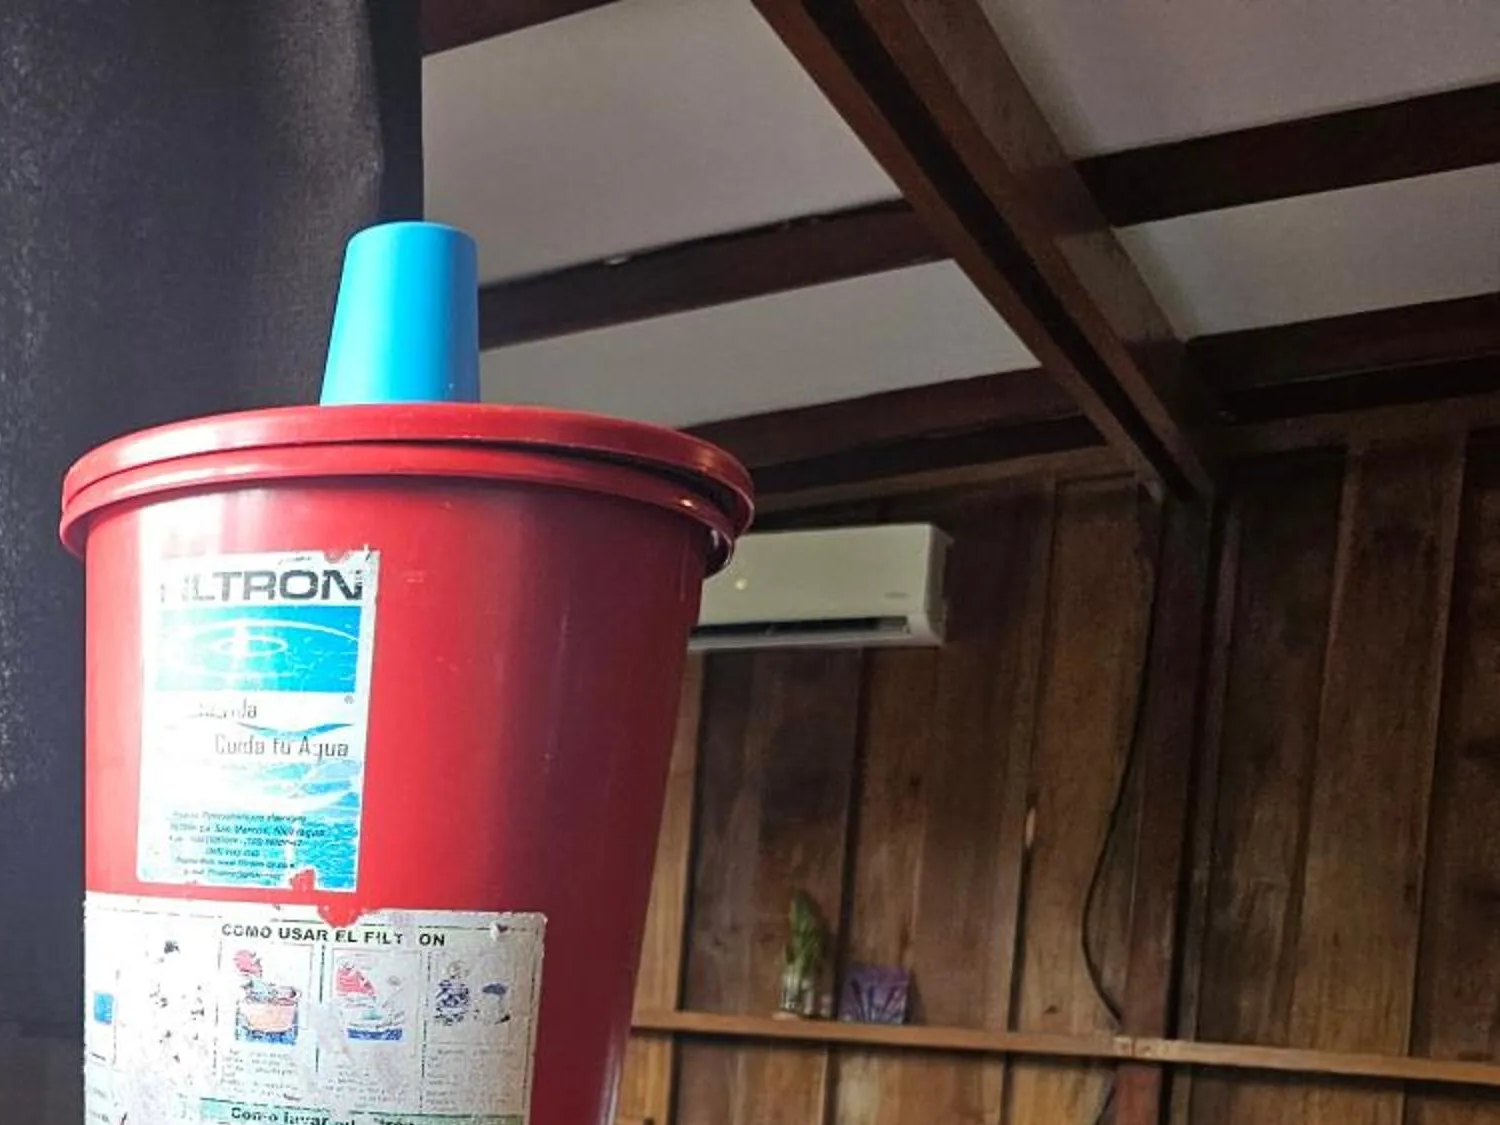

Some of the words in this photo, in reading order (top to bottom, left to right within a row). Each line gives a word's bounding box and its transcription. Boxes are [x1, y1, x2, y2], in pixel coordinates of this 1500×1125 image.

[298, 736, 349, 761] Agua
[221, 923, 272, 939] COMO
[278, 926, 329, 941] USAR
[335, 929, 358, 943] EL
[363, 931, 445, 947] FILTON
